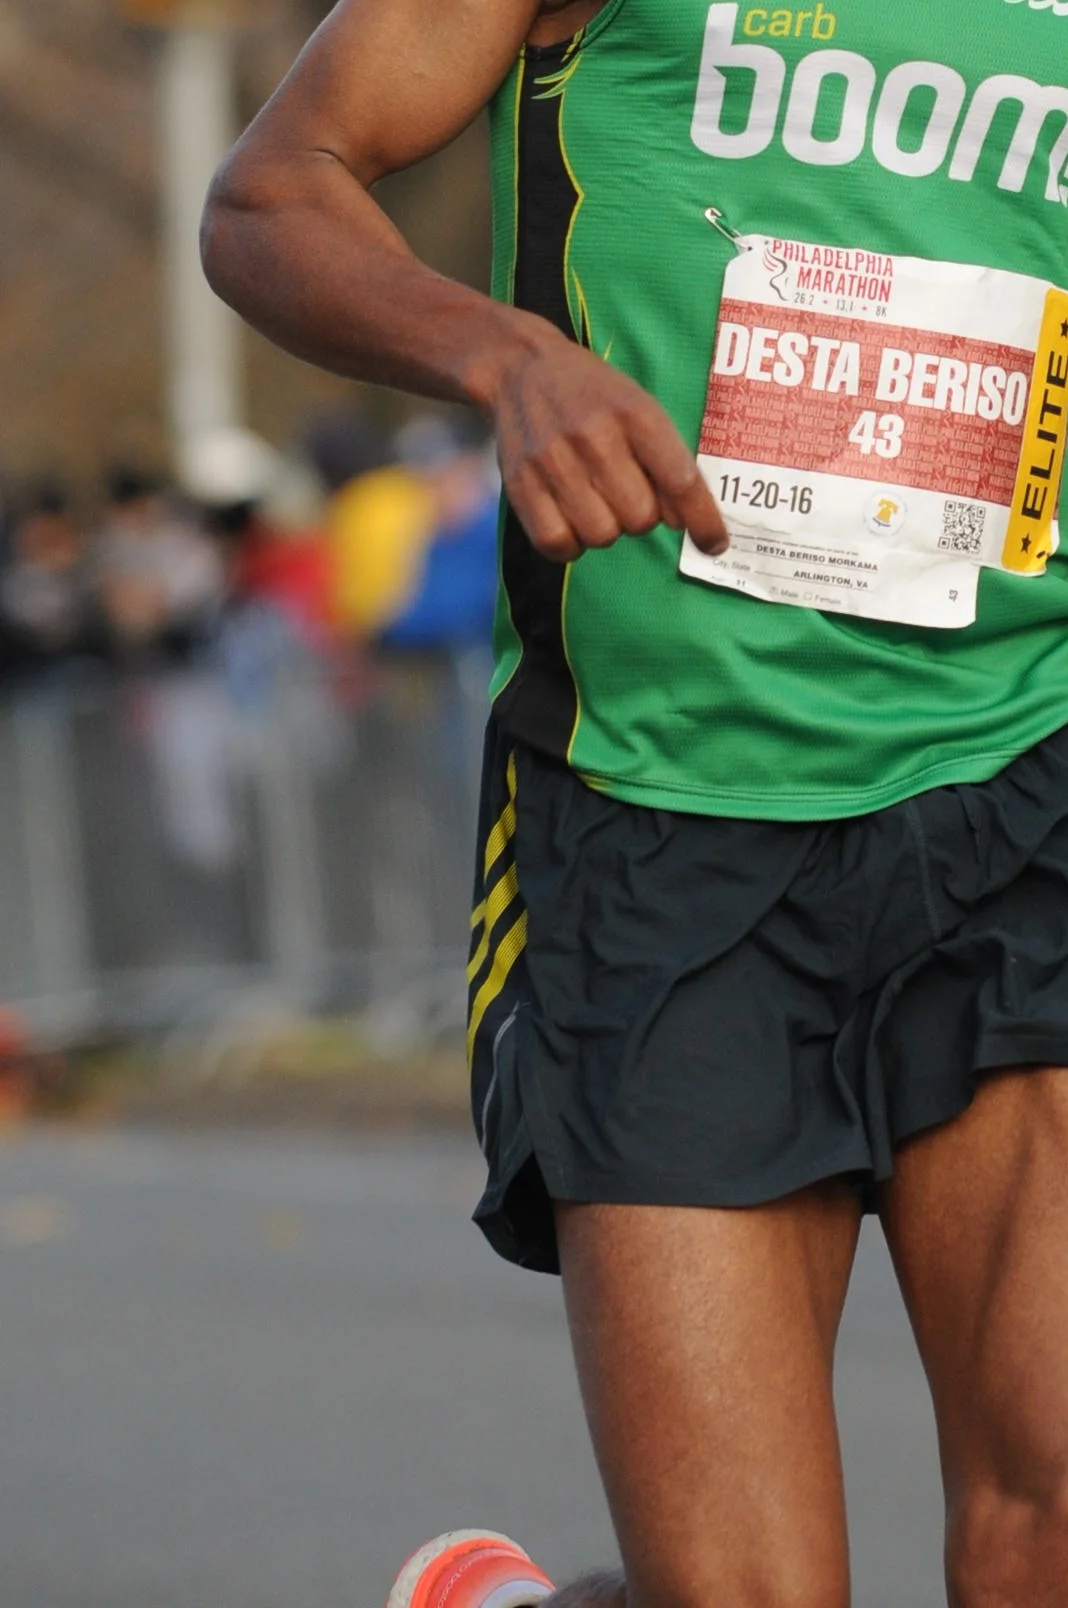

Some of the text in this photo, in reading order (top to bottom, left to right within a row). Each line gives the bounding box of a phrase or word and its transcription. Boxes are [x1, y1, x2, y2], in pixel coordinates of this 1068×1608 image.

[743, 3, 838, 41] carb
[772, 240, 894, 277] PHILADELPHIA
[794, 292, 815, 307] 262
[796, 267, 892, 303] MARATHON
[714, 322, 1028, 426] DESTA BERISO
[849, 410, 905, 459] 43
[720, 474, 813, 514] 11-20-16
[756, 545, 879, 571] DESTA BERISO MORKAMA
[857, 579, 869, 589] VA
